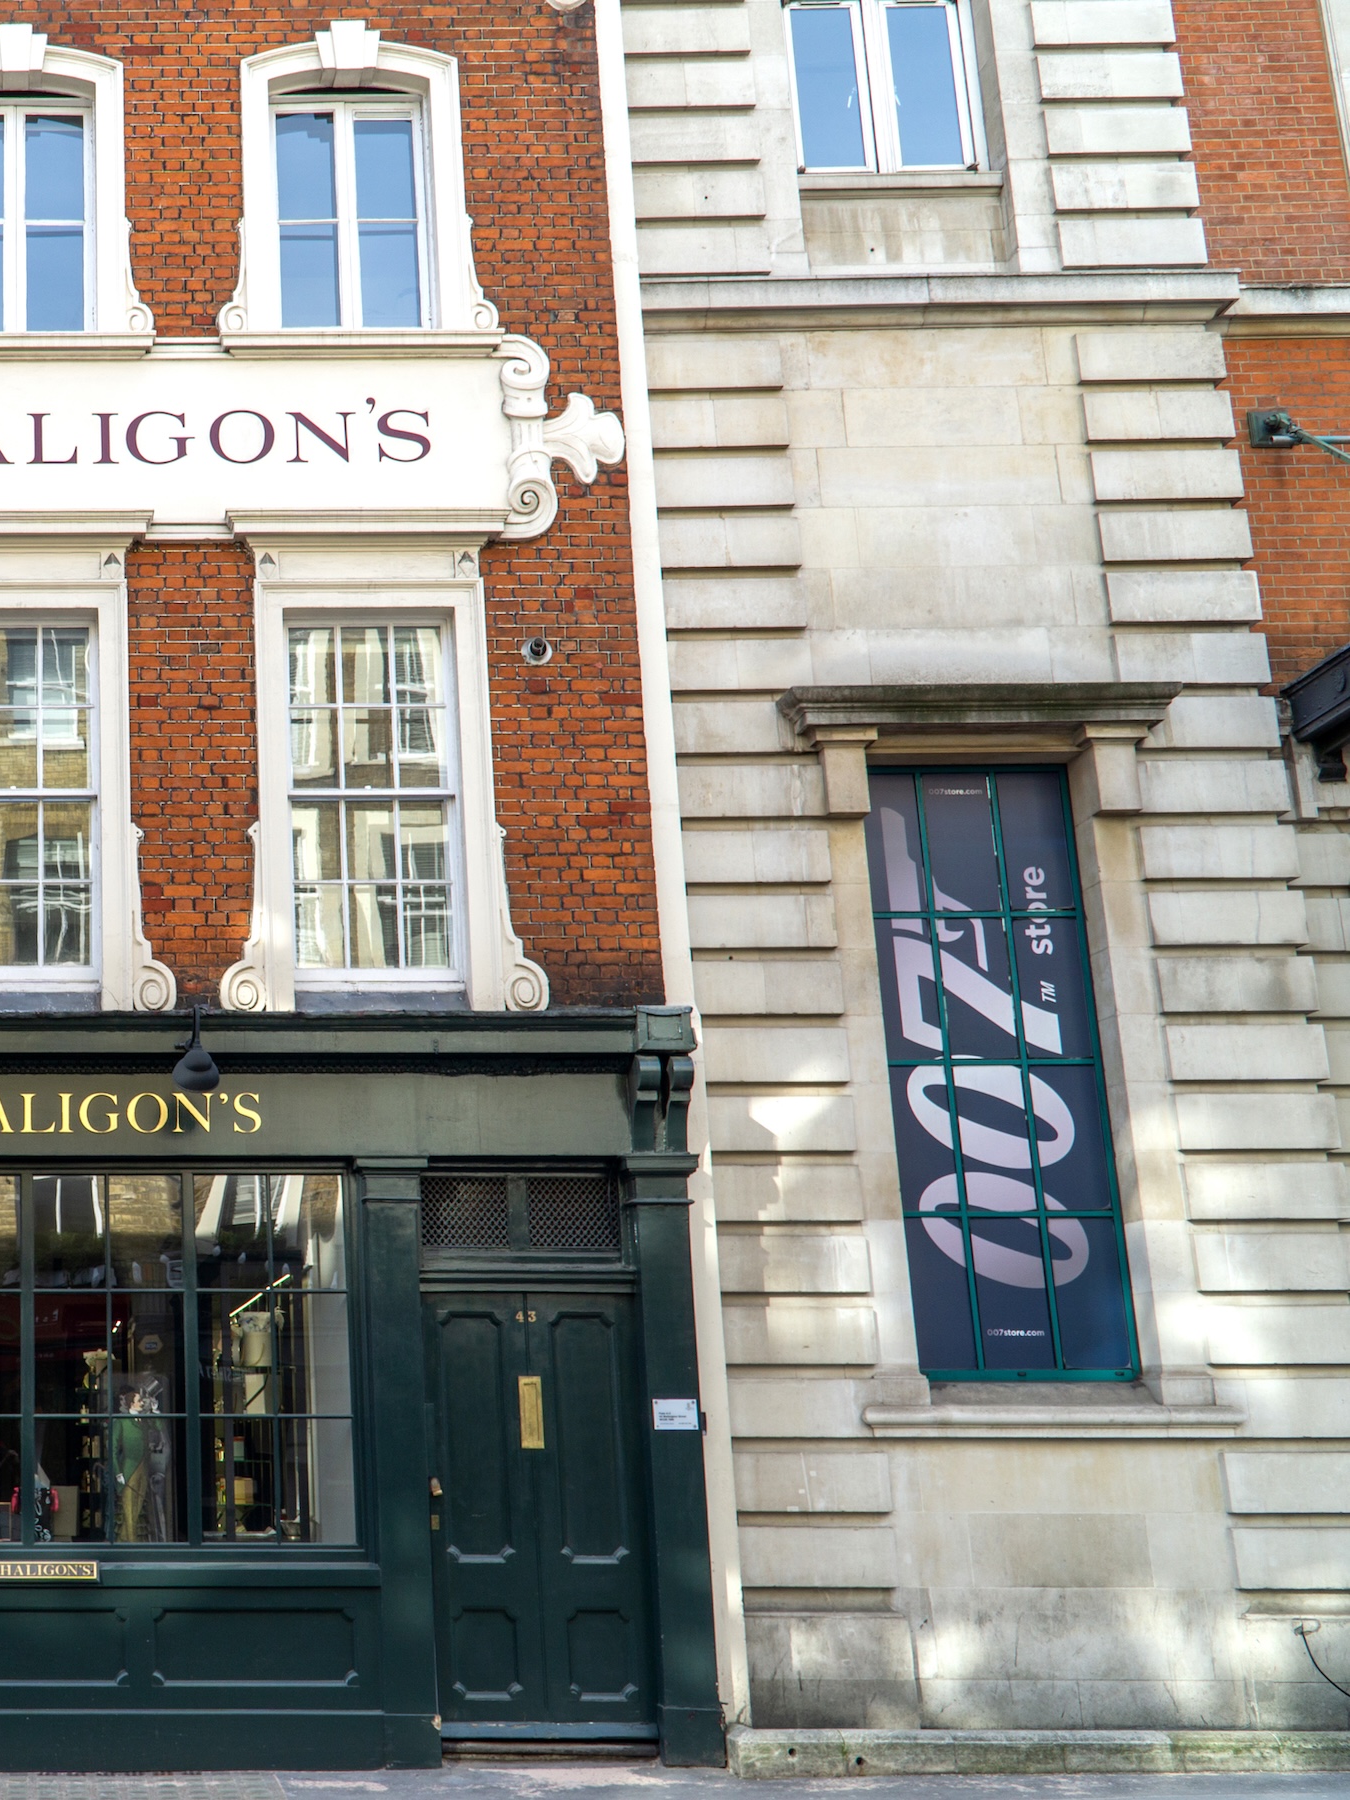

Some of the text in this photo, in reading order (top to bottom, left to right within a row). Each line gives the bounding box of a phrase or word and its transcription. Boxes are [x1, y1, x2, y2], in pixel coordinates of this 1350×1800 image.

[928, 788, 983, 796] 007store.com
[1023, 866, 1054, 955] store
[515, 1310, 537, 1323] 43
[986, 1329, 1045, 1337] 007store.com
